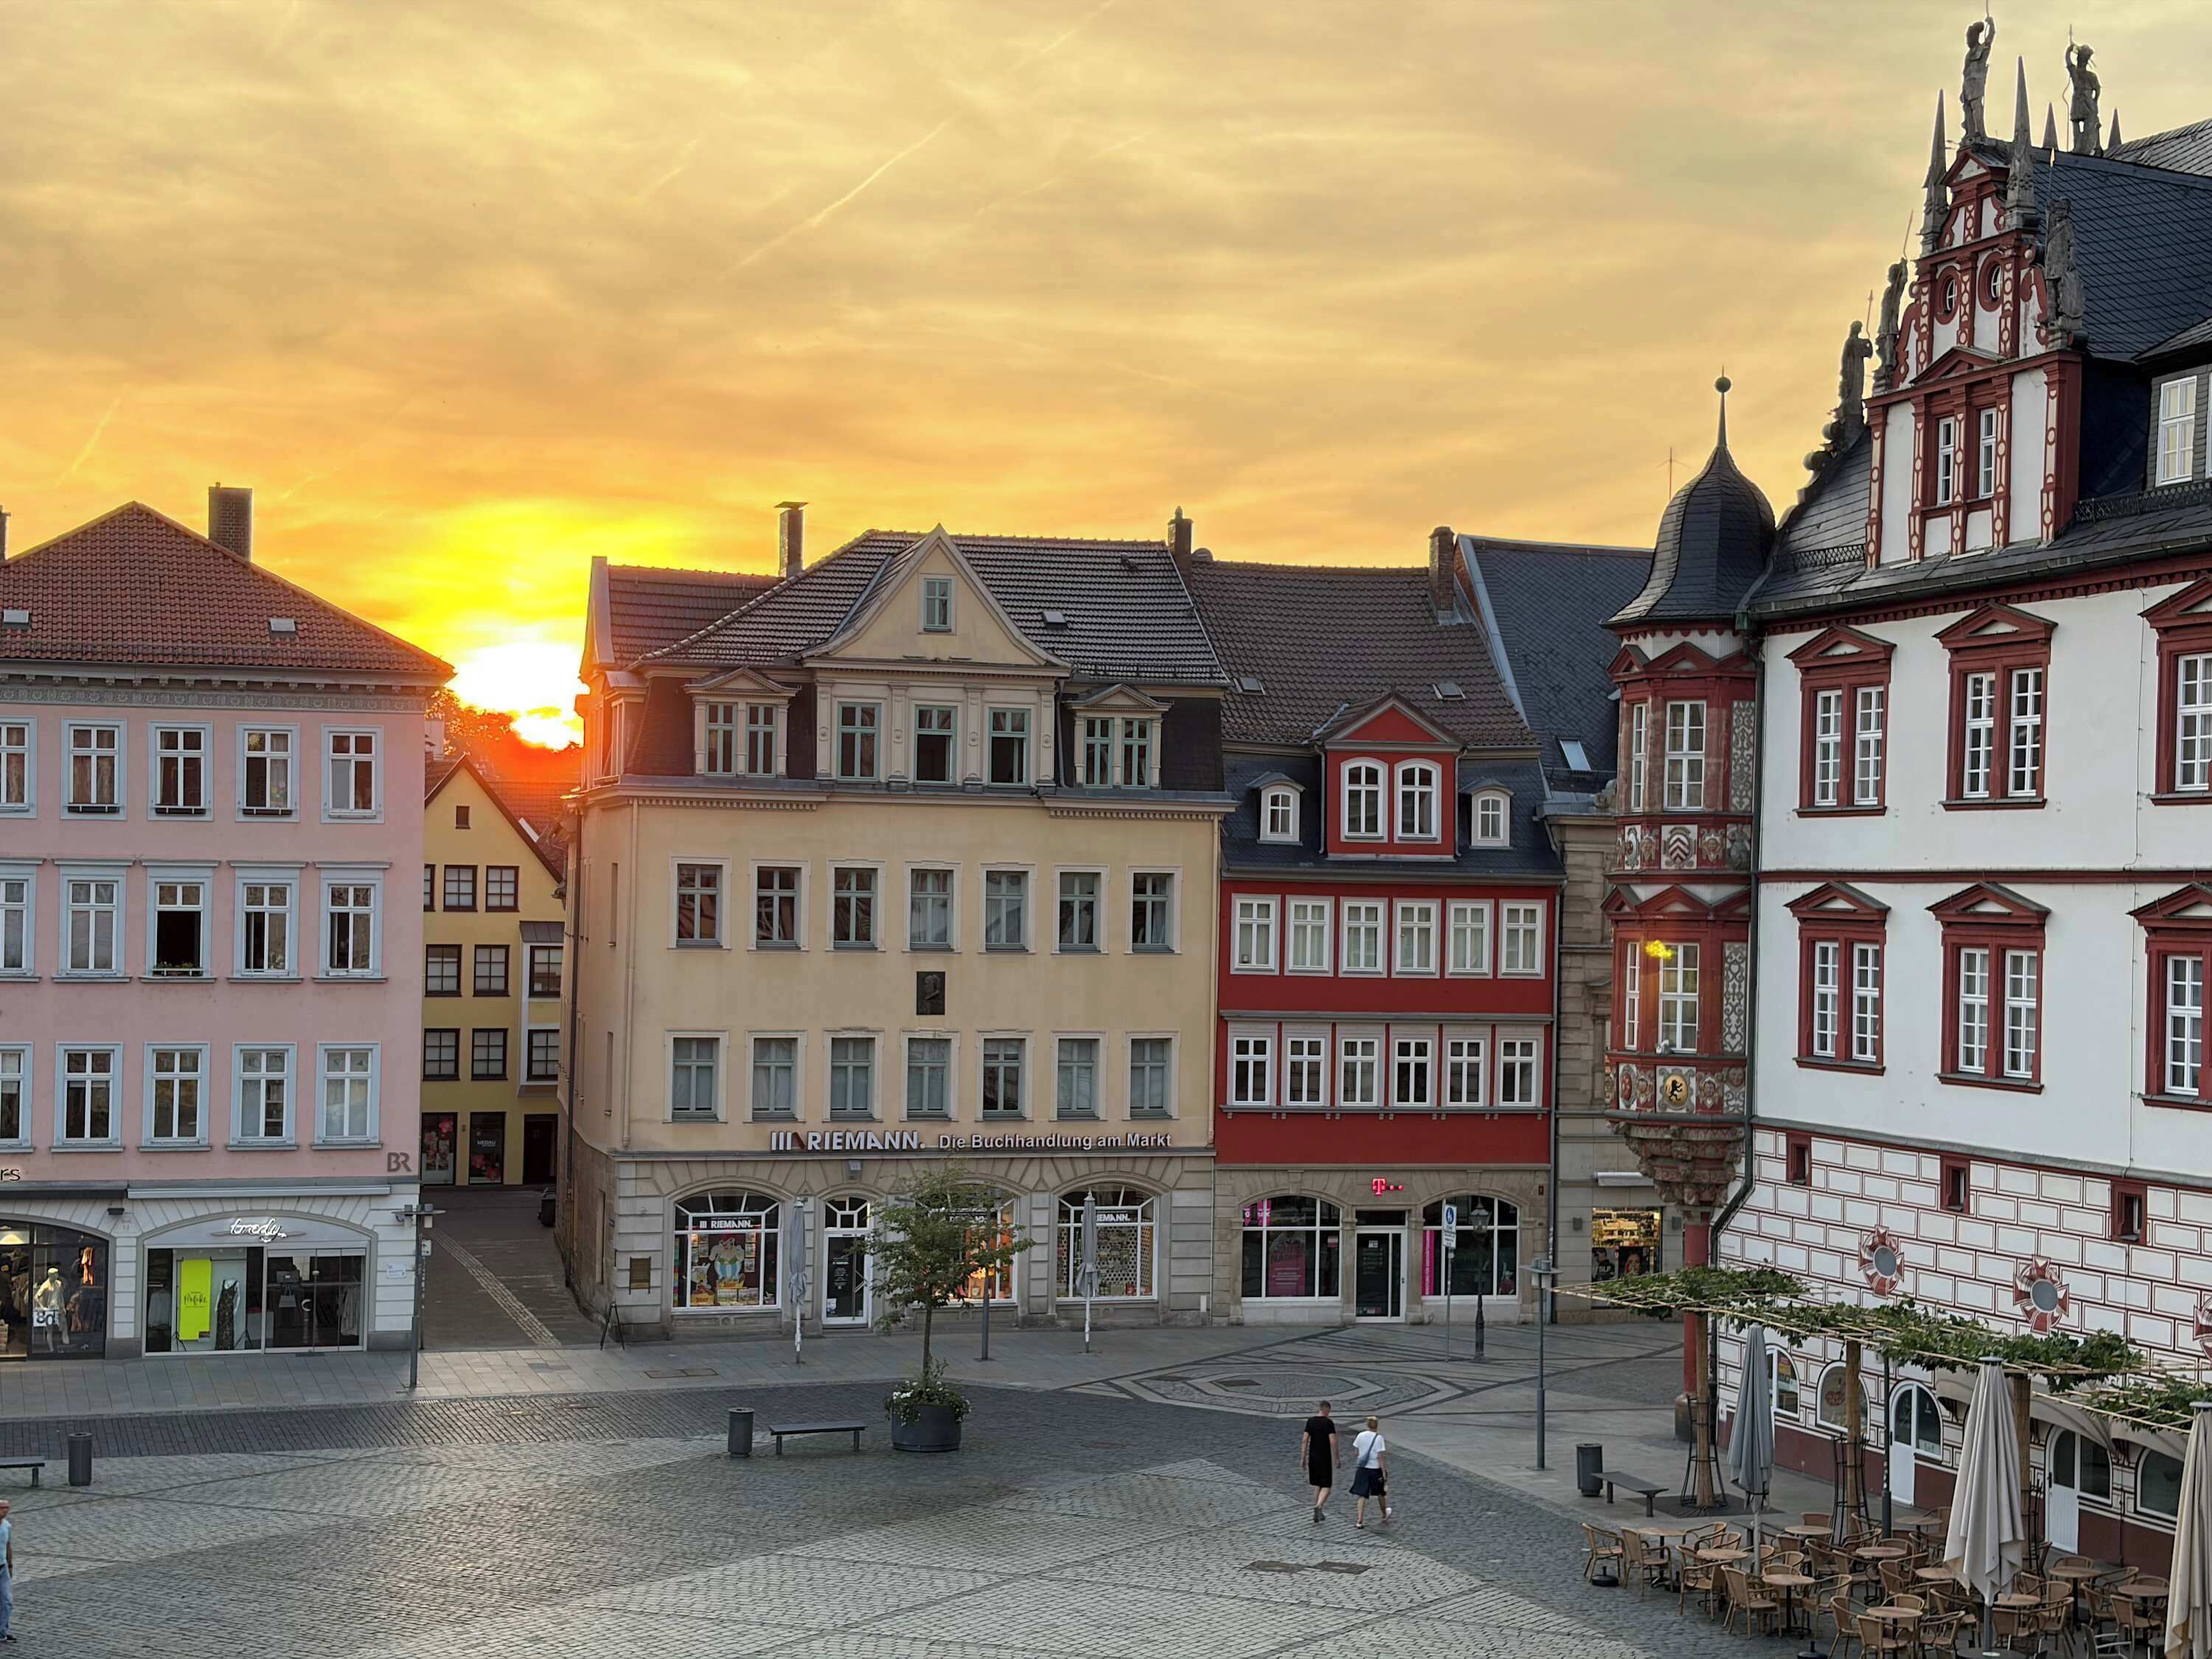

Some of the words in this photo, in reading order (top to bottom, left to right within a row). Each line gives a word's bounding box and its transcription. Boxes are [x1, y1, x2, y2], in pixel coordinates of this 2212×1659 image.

[807, 1131, 926, 1150] RIEMANN.
[939, 1135, 965, 1148] Die
[971, 1133, 1092, 1150] Buchhandlung
[1097, 1135, 1121, 1147] am
[1127, 1133, 1172, 1147] Markt
[387, 1152, 411, 1172] BR
[1096, 1214, 1130, 1222] IEMANN.
